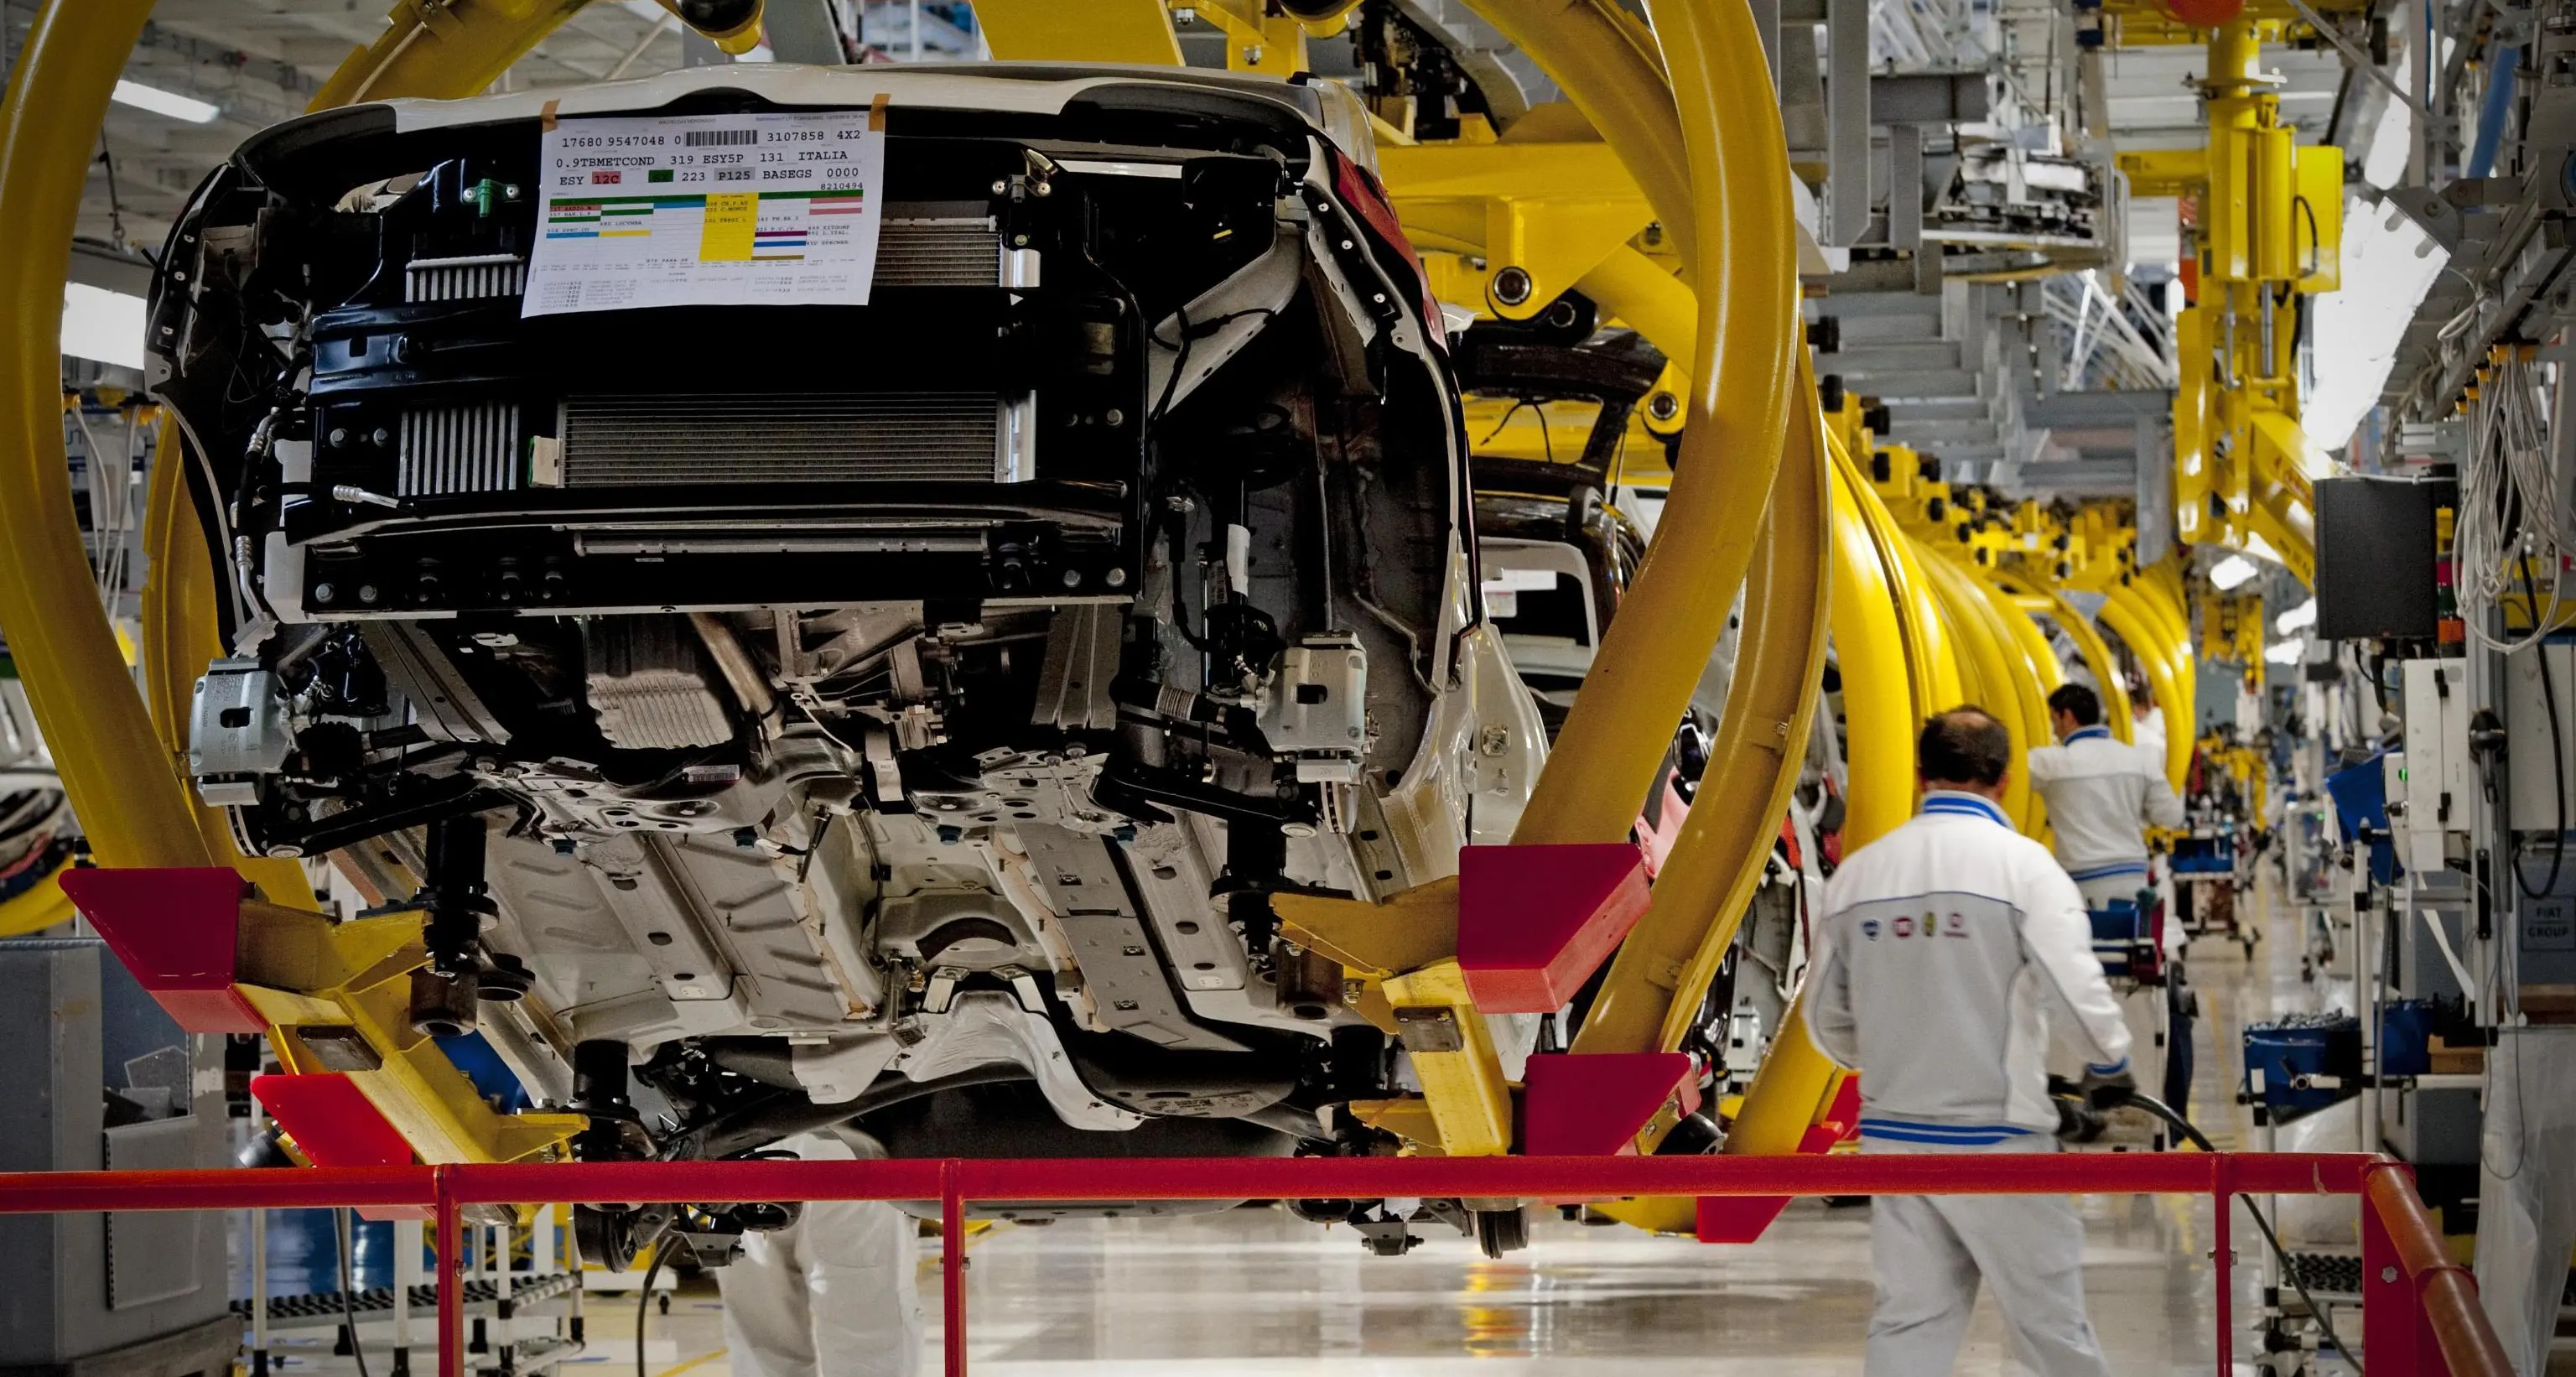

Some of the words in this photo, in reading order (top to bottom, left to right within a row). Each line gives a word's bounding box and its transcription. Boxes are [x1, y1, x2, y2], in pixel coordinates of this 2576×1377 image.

[562, 138, 602, 148] 17680
[607, 136, 665, 147] 9547048
[674, 135, 682, 145] 0
[767, 131, 824, 142] 3107858
[837, 130, 860, 140] 4X2
[556, 157, 655, 168] 0.9TBMETCOND
[670, 155, 694, 165] 319
[703, 154, 744, 164] ESY5P
[760, 153, 784, 163] 131
[798, 151, 848, 161] ITALIA
[559, 176, 584, 185] ESY
[595, 174, 620, 184] 12C
[682, 172, 705, 181] 223
[719, 171, 750, 180] P125
[763, 169, 812, 179] BASEGS
[827, 168, 859, 177] 0000
[820, 182, 863, 190] 8210494
[2537, 907, 2562, 918] FIAT
[2528, 927, 2568, 938] GROUP
